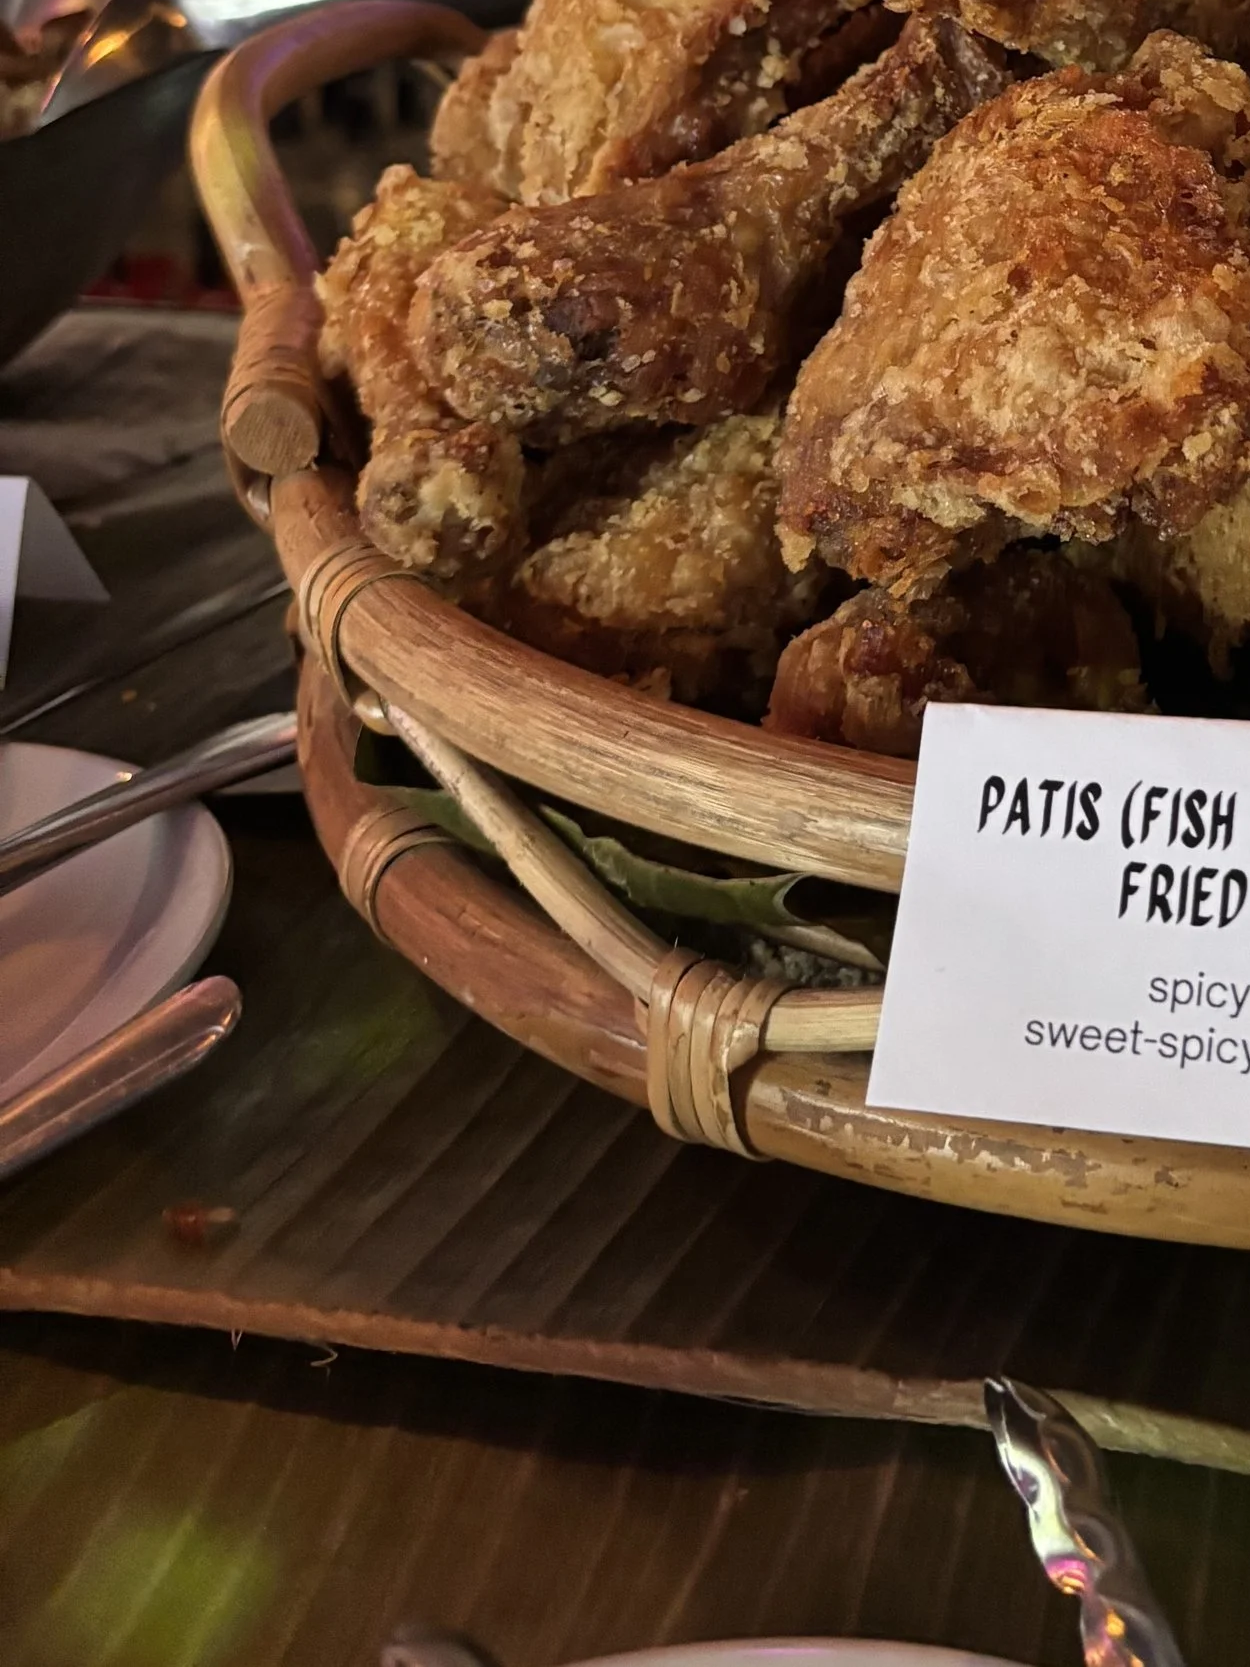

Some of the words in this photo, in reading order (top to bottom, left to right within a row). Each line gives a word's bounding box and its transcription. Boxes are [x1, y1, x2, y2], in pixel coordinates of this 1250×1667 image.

[976, 774, 1103, 841] PATIS
[1121, 780, 1237, 851] (FISH
[1117, 861, 1249, 930] FRIED
